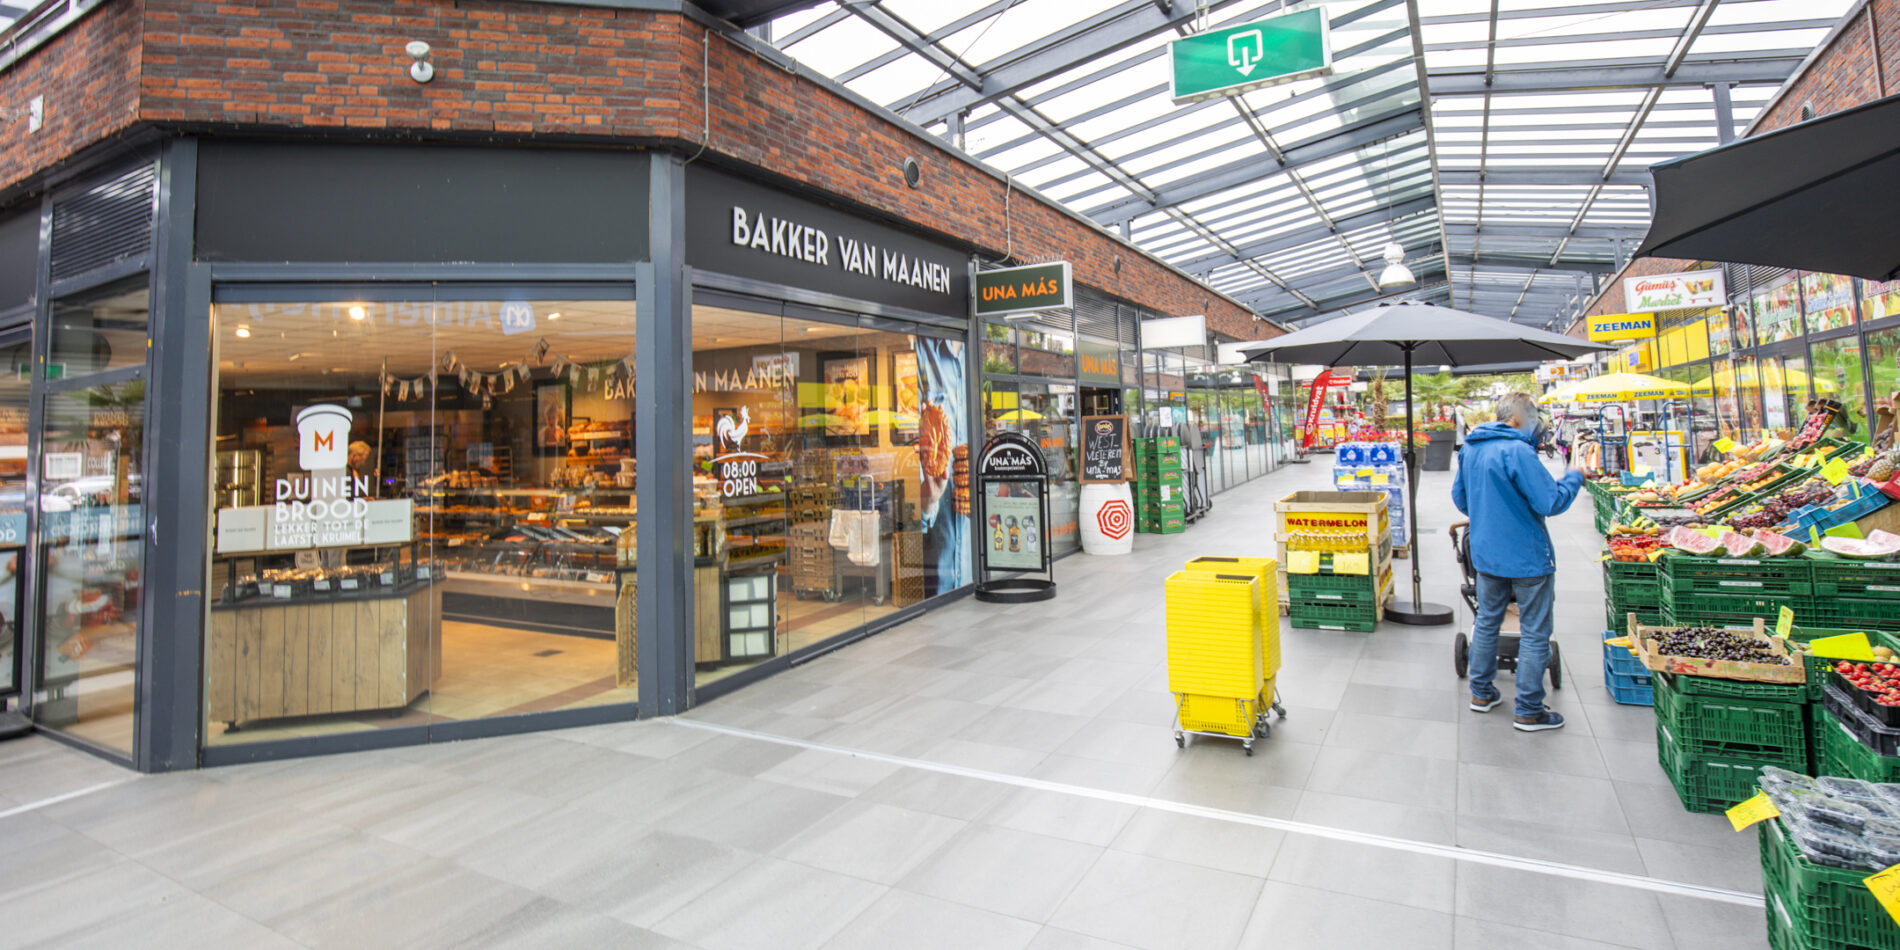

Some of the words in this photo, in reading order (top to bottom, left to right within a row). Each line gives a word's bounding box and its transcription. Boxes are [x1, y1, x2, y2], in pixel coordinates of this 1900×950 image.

[733, 206, 829, 266] BAKKER
[838, 235, 876, 278] VAN
[883, 248, 950, 295] MAANEN
[982, 284, 1017, 301] UNA
[1021, 276, 1058, 298] MÁS
[1637, 292, 1682, 309] Market
[1593, 320, 1651, 333] ZEEMAN
[1081, 354, 1099, 374] UNA
[1101, 352, 1117, 376] MÁS
[714, 363, 795, 393] MAANEN
[1308, 386, 1324, 423] Kruidvat
[314, 430, 334, 452] M
[723, 460, 757, 478] 08:00
[989, 456, 1009, 466] UNA
[1011, 453, 1032, 465] MÁS
[276, 475, 369, 500] DUINEN
[723, 477, 757, 497] OPEN
[275, 498, 369, 522] BROOD
[274, 522, 318, 534] LEKKER
[324, 520, 350, 531] TOT
[355, 519, 369, 530] DE
[1287, 518, 1367, 527] WATERMELON
[274, 533, 318, 546] LAATSTE
